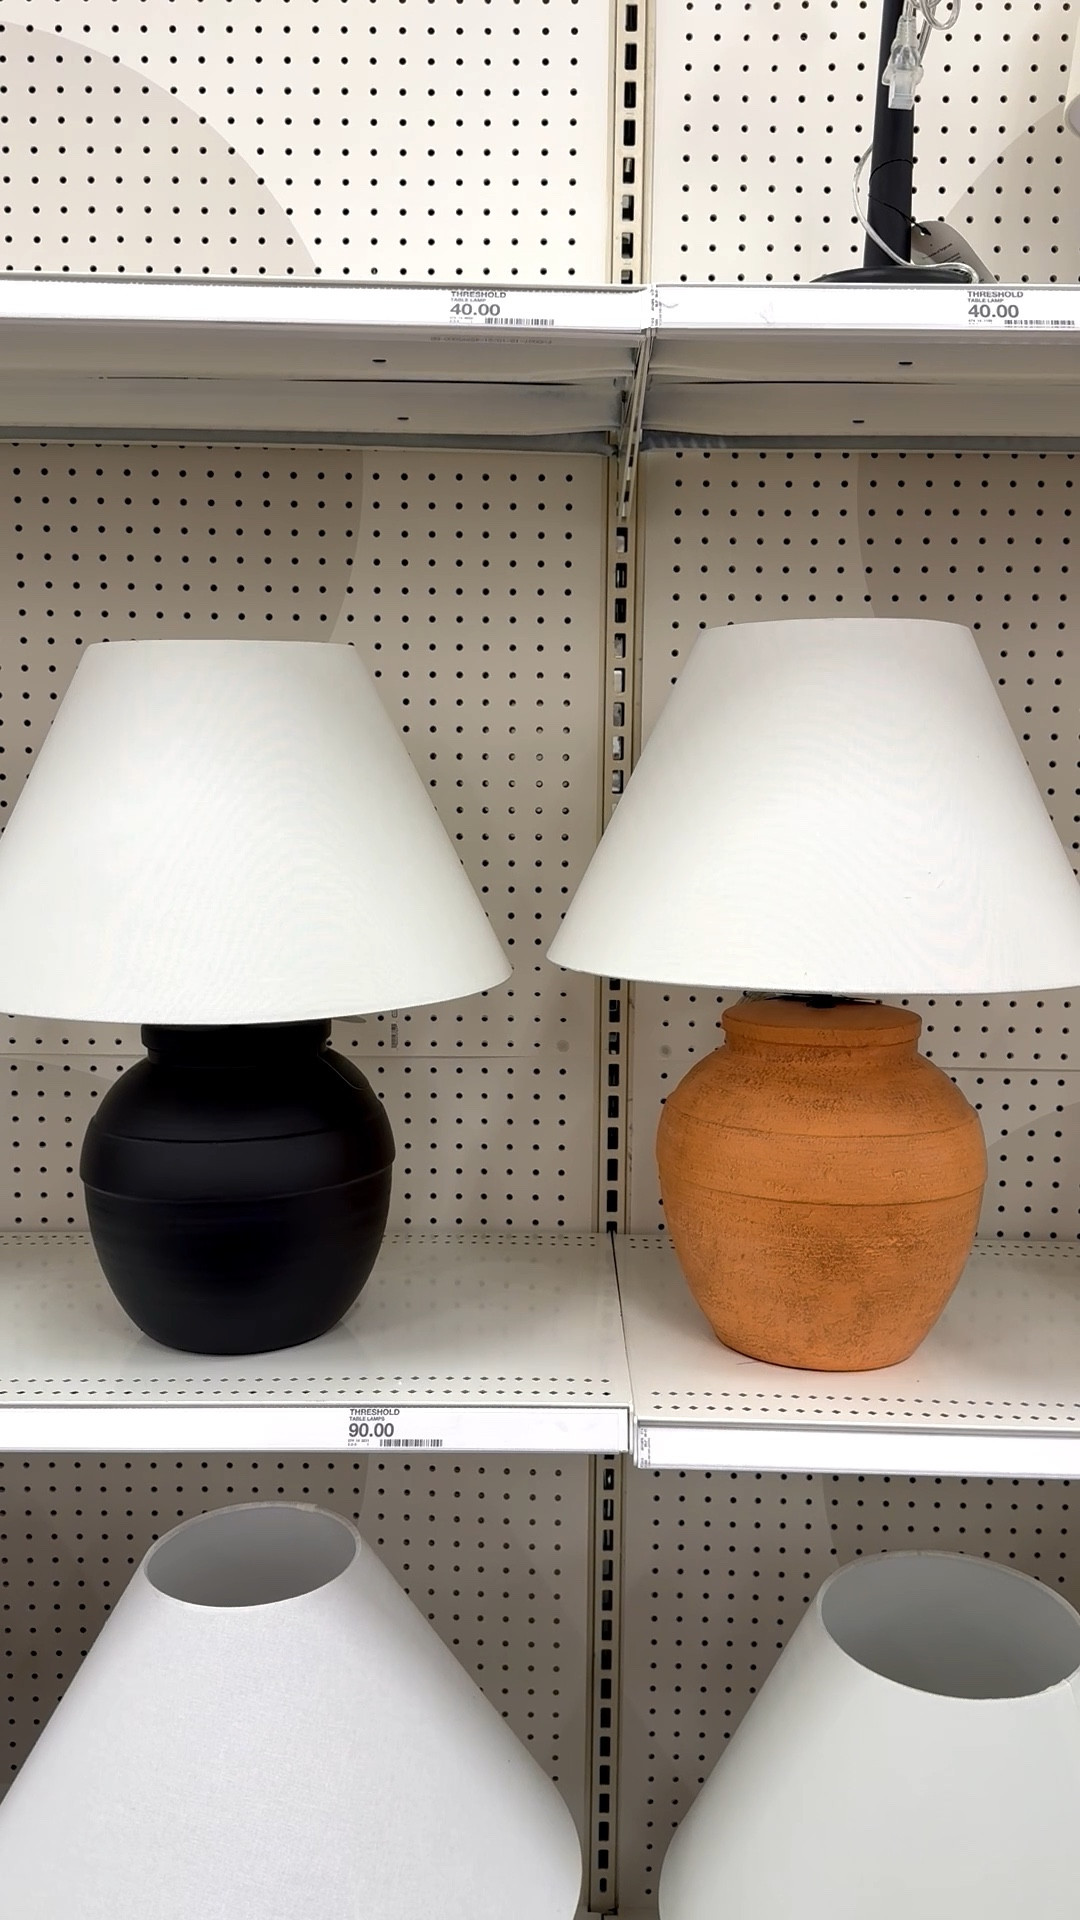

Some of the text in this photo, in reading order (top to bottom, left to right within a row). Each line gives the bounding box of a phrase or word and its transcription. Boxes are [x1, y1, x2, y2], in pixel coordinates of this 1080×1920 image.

[450, 303, 501, 316] 40.00
[968, 304, 1019, 318] 40.00
[350, 1408, 400, 1416] THRESHOLD
[348, 1423, 395, 1438] 90.00
